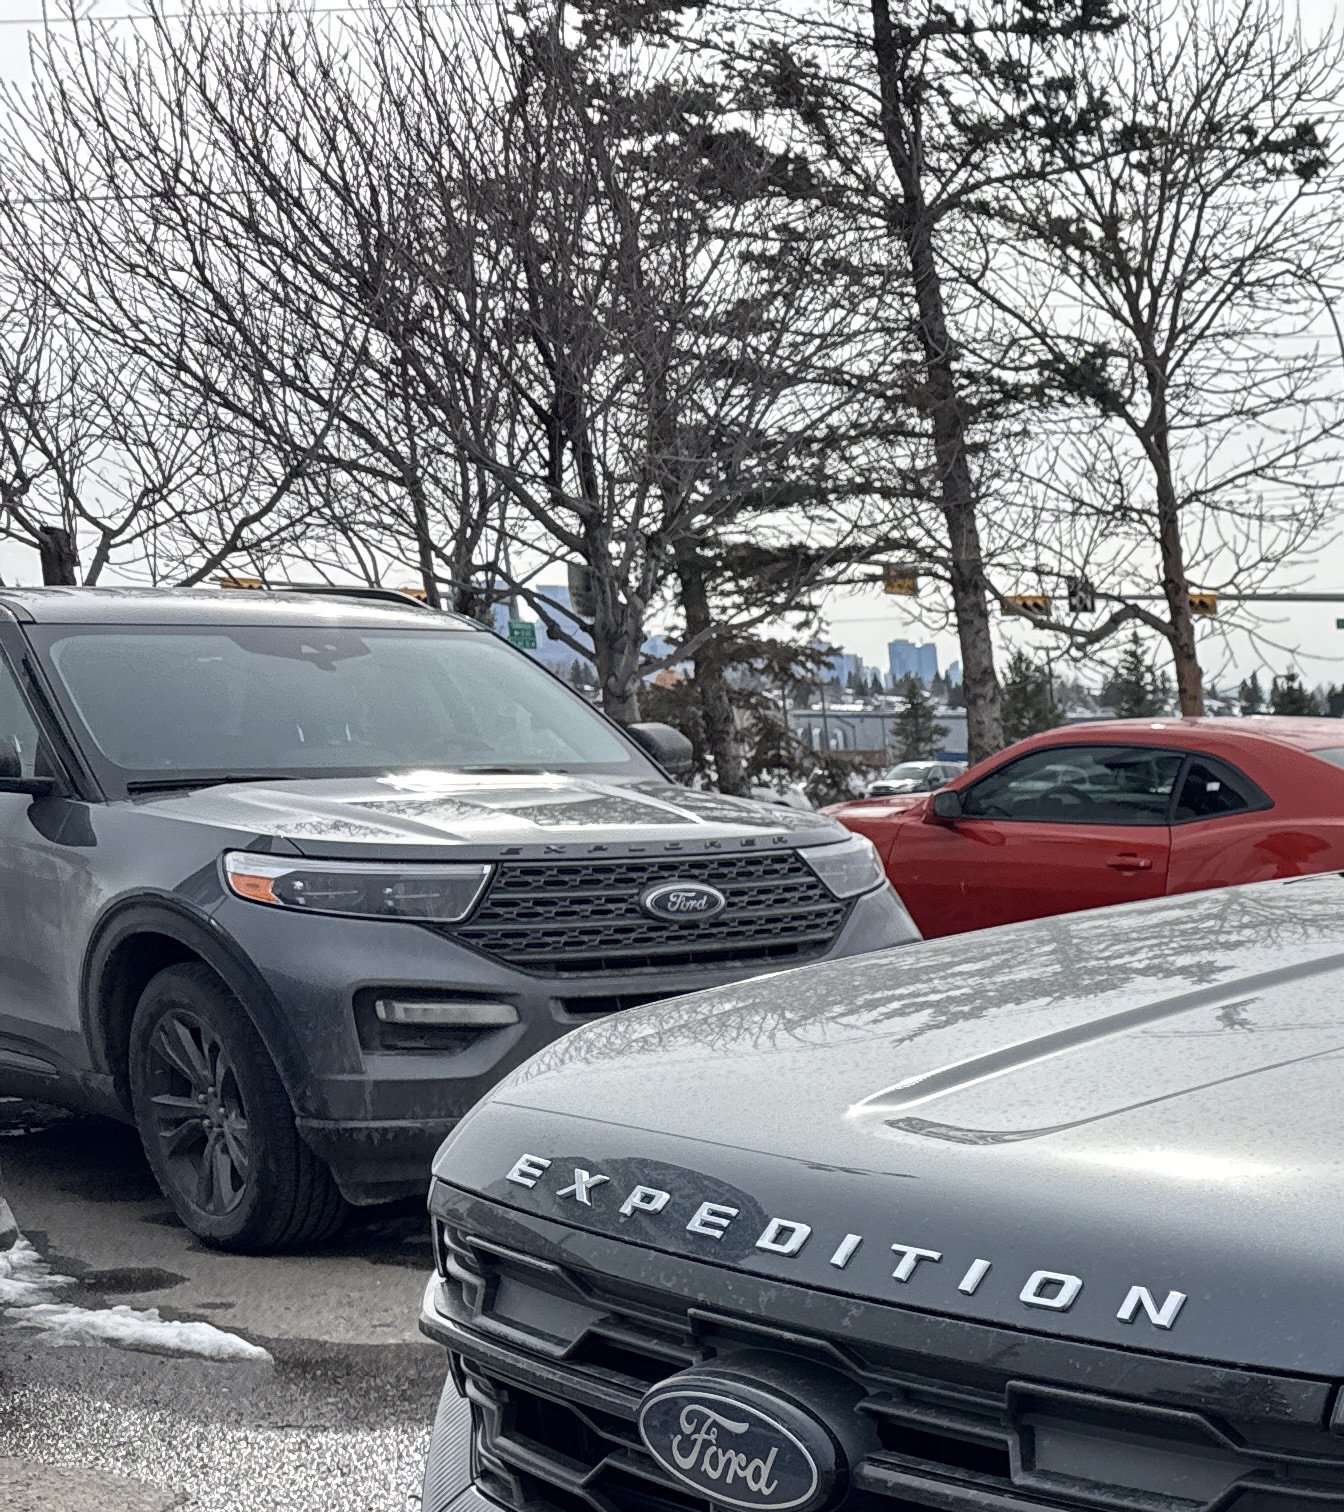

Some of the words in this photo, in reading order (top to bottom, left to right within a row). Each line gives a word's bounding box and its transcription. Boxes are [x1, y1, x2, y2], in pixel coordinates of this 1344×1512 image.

[667, 891, 709, 913] Ford
[505, 1152, 1188, 1330] EXPEDITION
[671, 1403, 779, 1496] Ford
